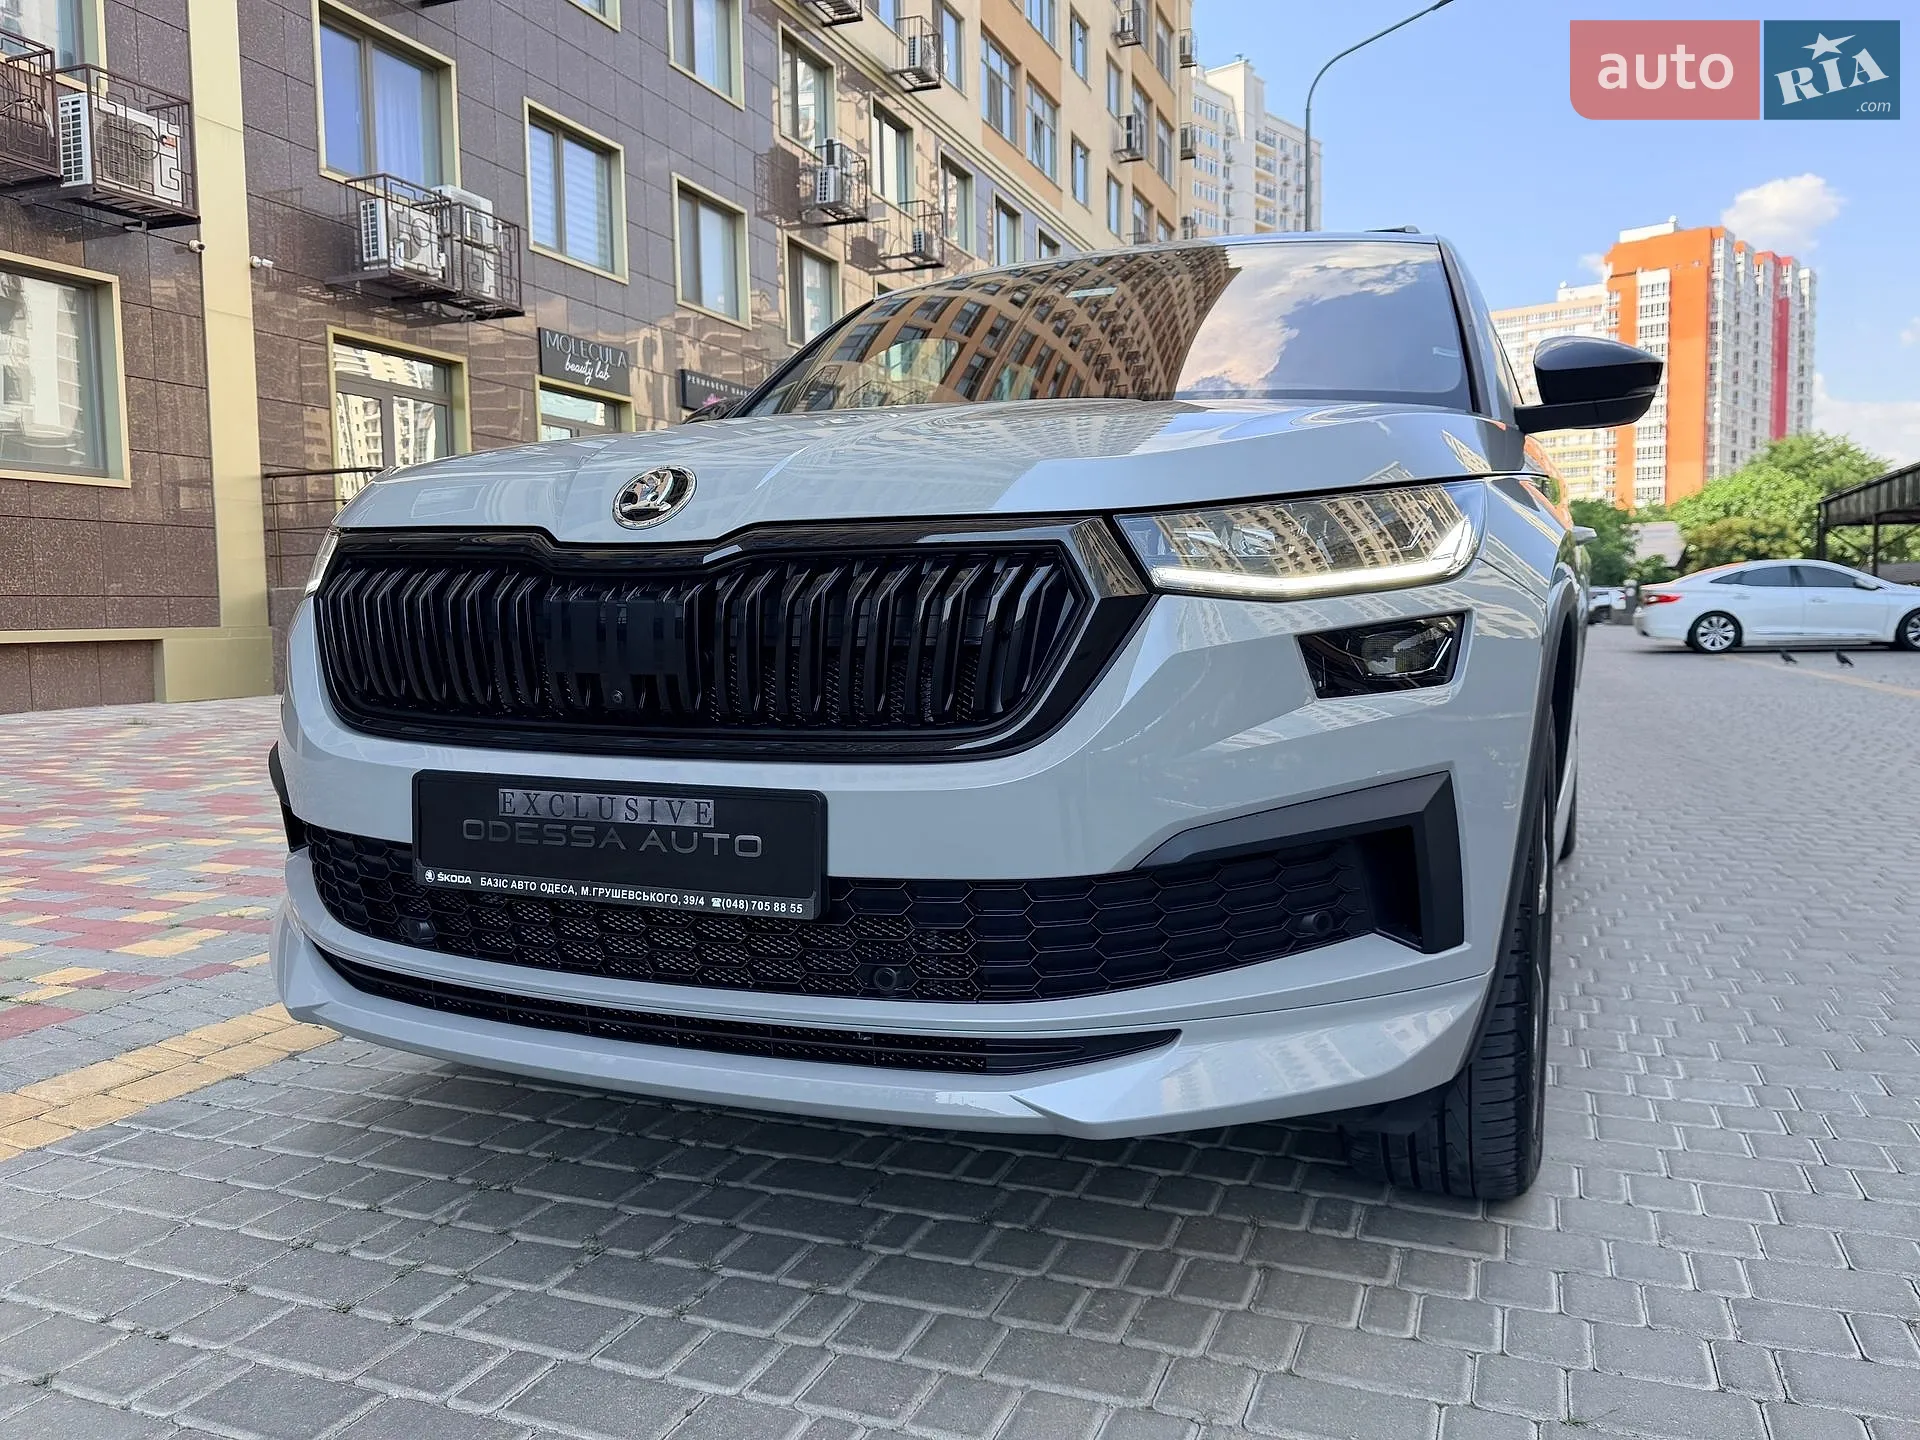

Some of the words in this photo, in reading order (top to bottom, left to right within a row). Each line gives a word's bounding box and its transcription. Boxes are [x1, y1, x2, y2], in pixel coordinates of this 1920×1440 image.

[546, 331, 628, 369] MOLECULA
[565, 353, 594, 386] beauty
[595, 360, 611, 381] lab
[687, 374, 728, 392] PERMANENT
[501, 791, 713, 826] EXCLUSIVE
[462, 818, 627, 851] ODESSA
[639, 828, 763, 859] AUTO
[437, 872, 472, 885] ŠKODA
[480, 877, 509, 889] БАЗІС
[510, 881, 537, 892] АВТО
[540, 882, 578, 896] ОДЕСА,
[683, 894, 705, 907] 39/4
[751, 900, 771, 912] 705
[773, 902, 787, 913] 88
[790, 903, 803, 914] 55
